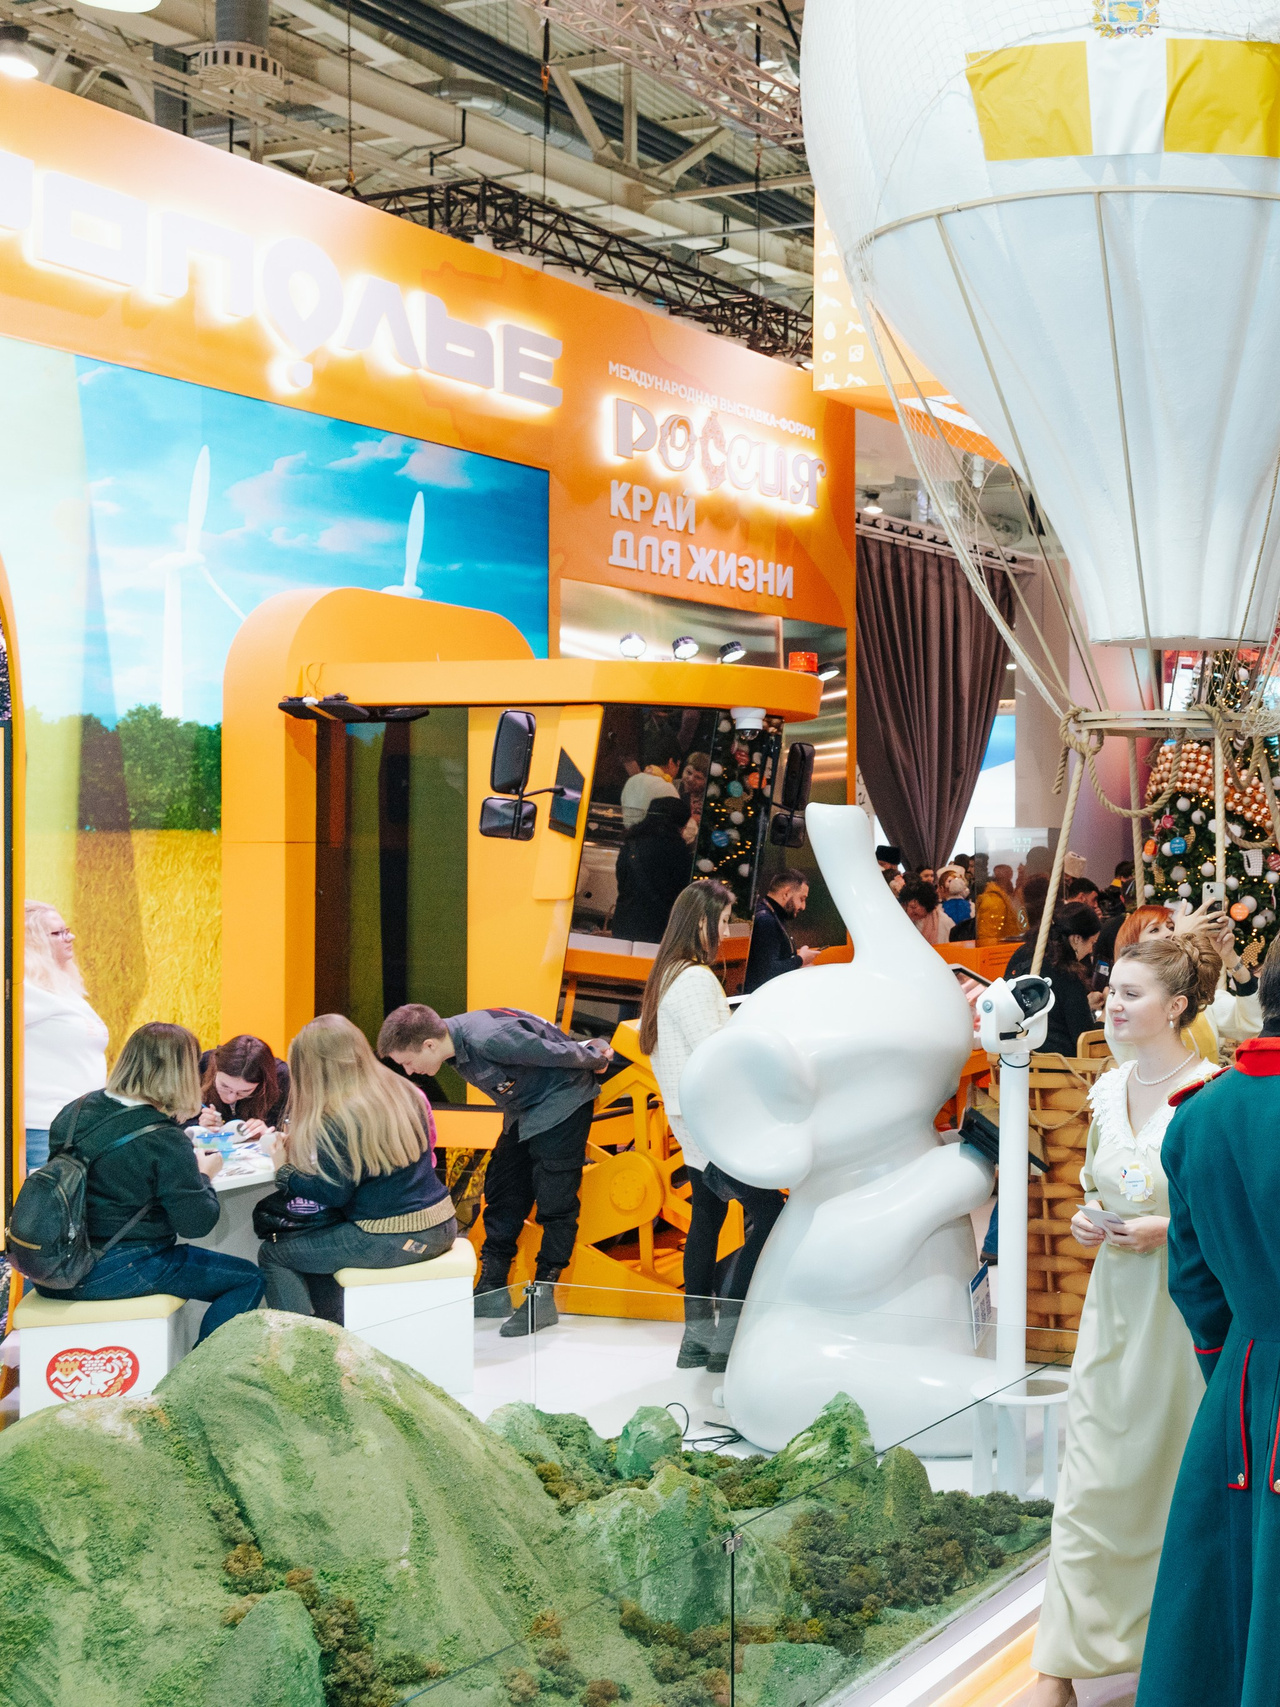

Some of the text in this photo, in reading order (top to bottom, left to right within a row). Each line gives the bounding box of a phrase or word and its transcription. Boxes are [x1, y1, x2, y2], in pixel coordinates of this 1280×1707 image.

[608, 361, 816, 441] МЕЖДУНАРОДНАЯ ВЫСТАВКА-ФОРУМ
[615, 398, 828, 508] РОССИЯ
[610, 480, 696, 534] КРАЙ
[608, 530, 794, 599] ДЛЯ ЖИЗНИ
